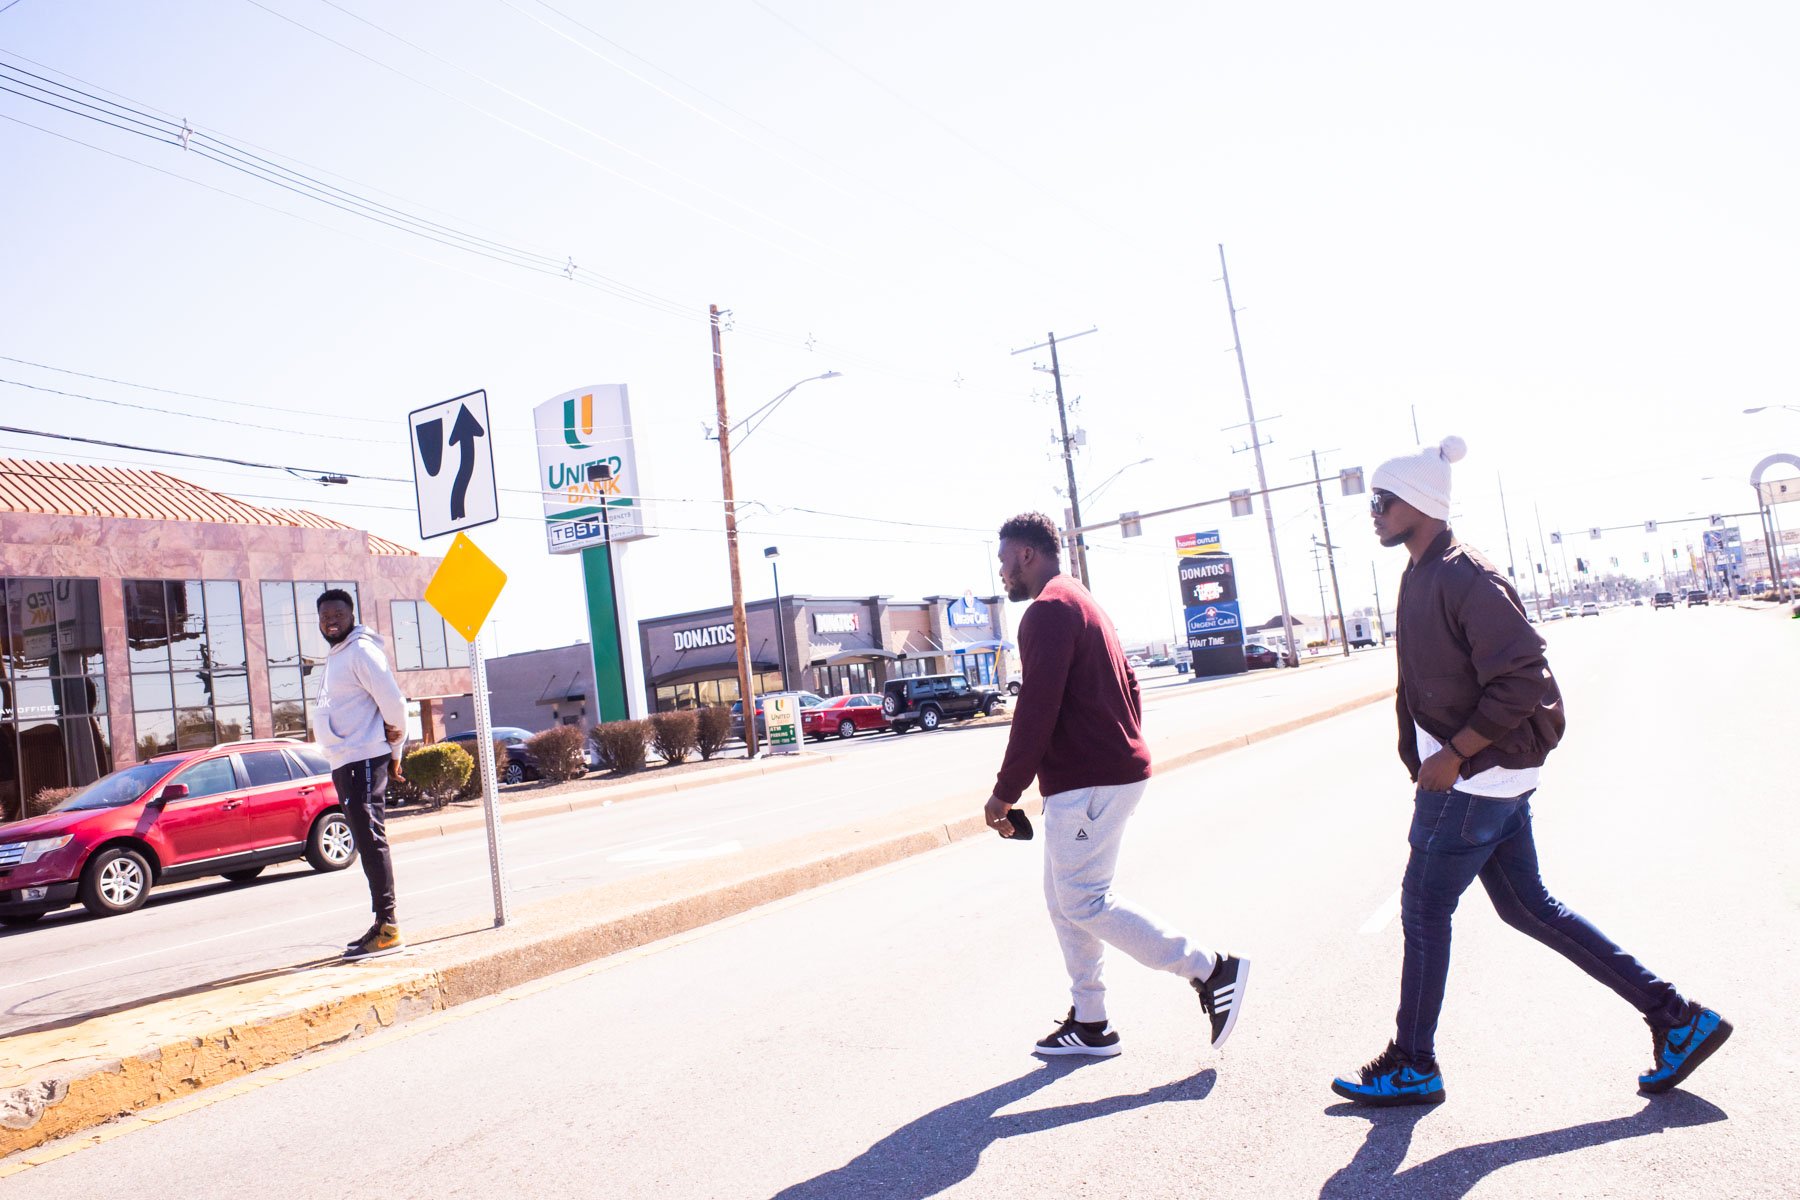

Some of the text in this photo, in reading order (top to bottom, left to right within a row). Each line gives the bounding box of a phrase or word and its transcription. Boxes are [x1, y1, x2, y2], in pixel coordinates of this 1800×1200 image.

[549, 456, 621, 489] UNID
[553, 520, 598, 540] TBSF
[1196, 536, 1218, 545] OUTLET
[1181, 563, 1225, 581] DONATOS
[1190, 620, 1217, 630] URGENT
[1217, 618, 1235, 626] CARE
[673, 624, 736, 651] DONATOS
[1189, 636, 1225, 649] WAIT TIME
[17, 704, 60, 714] OFFICES
